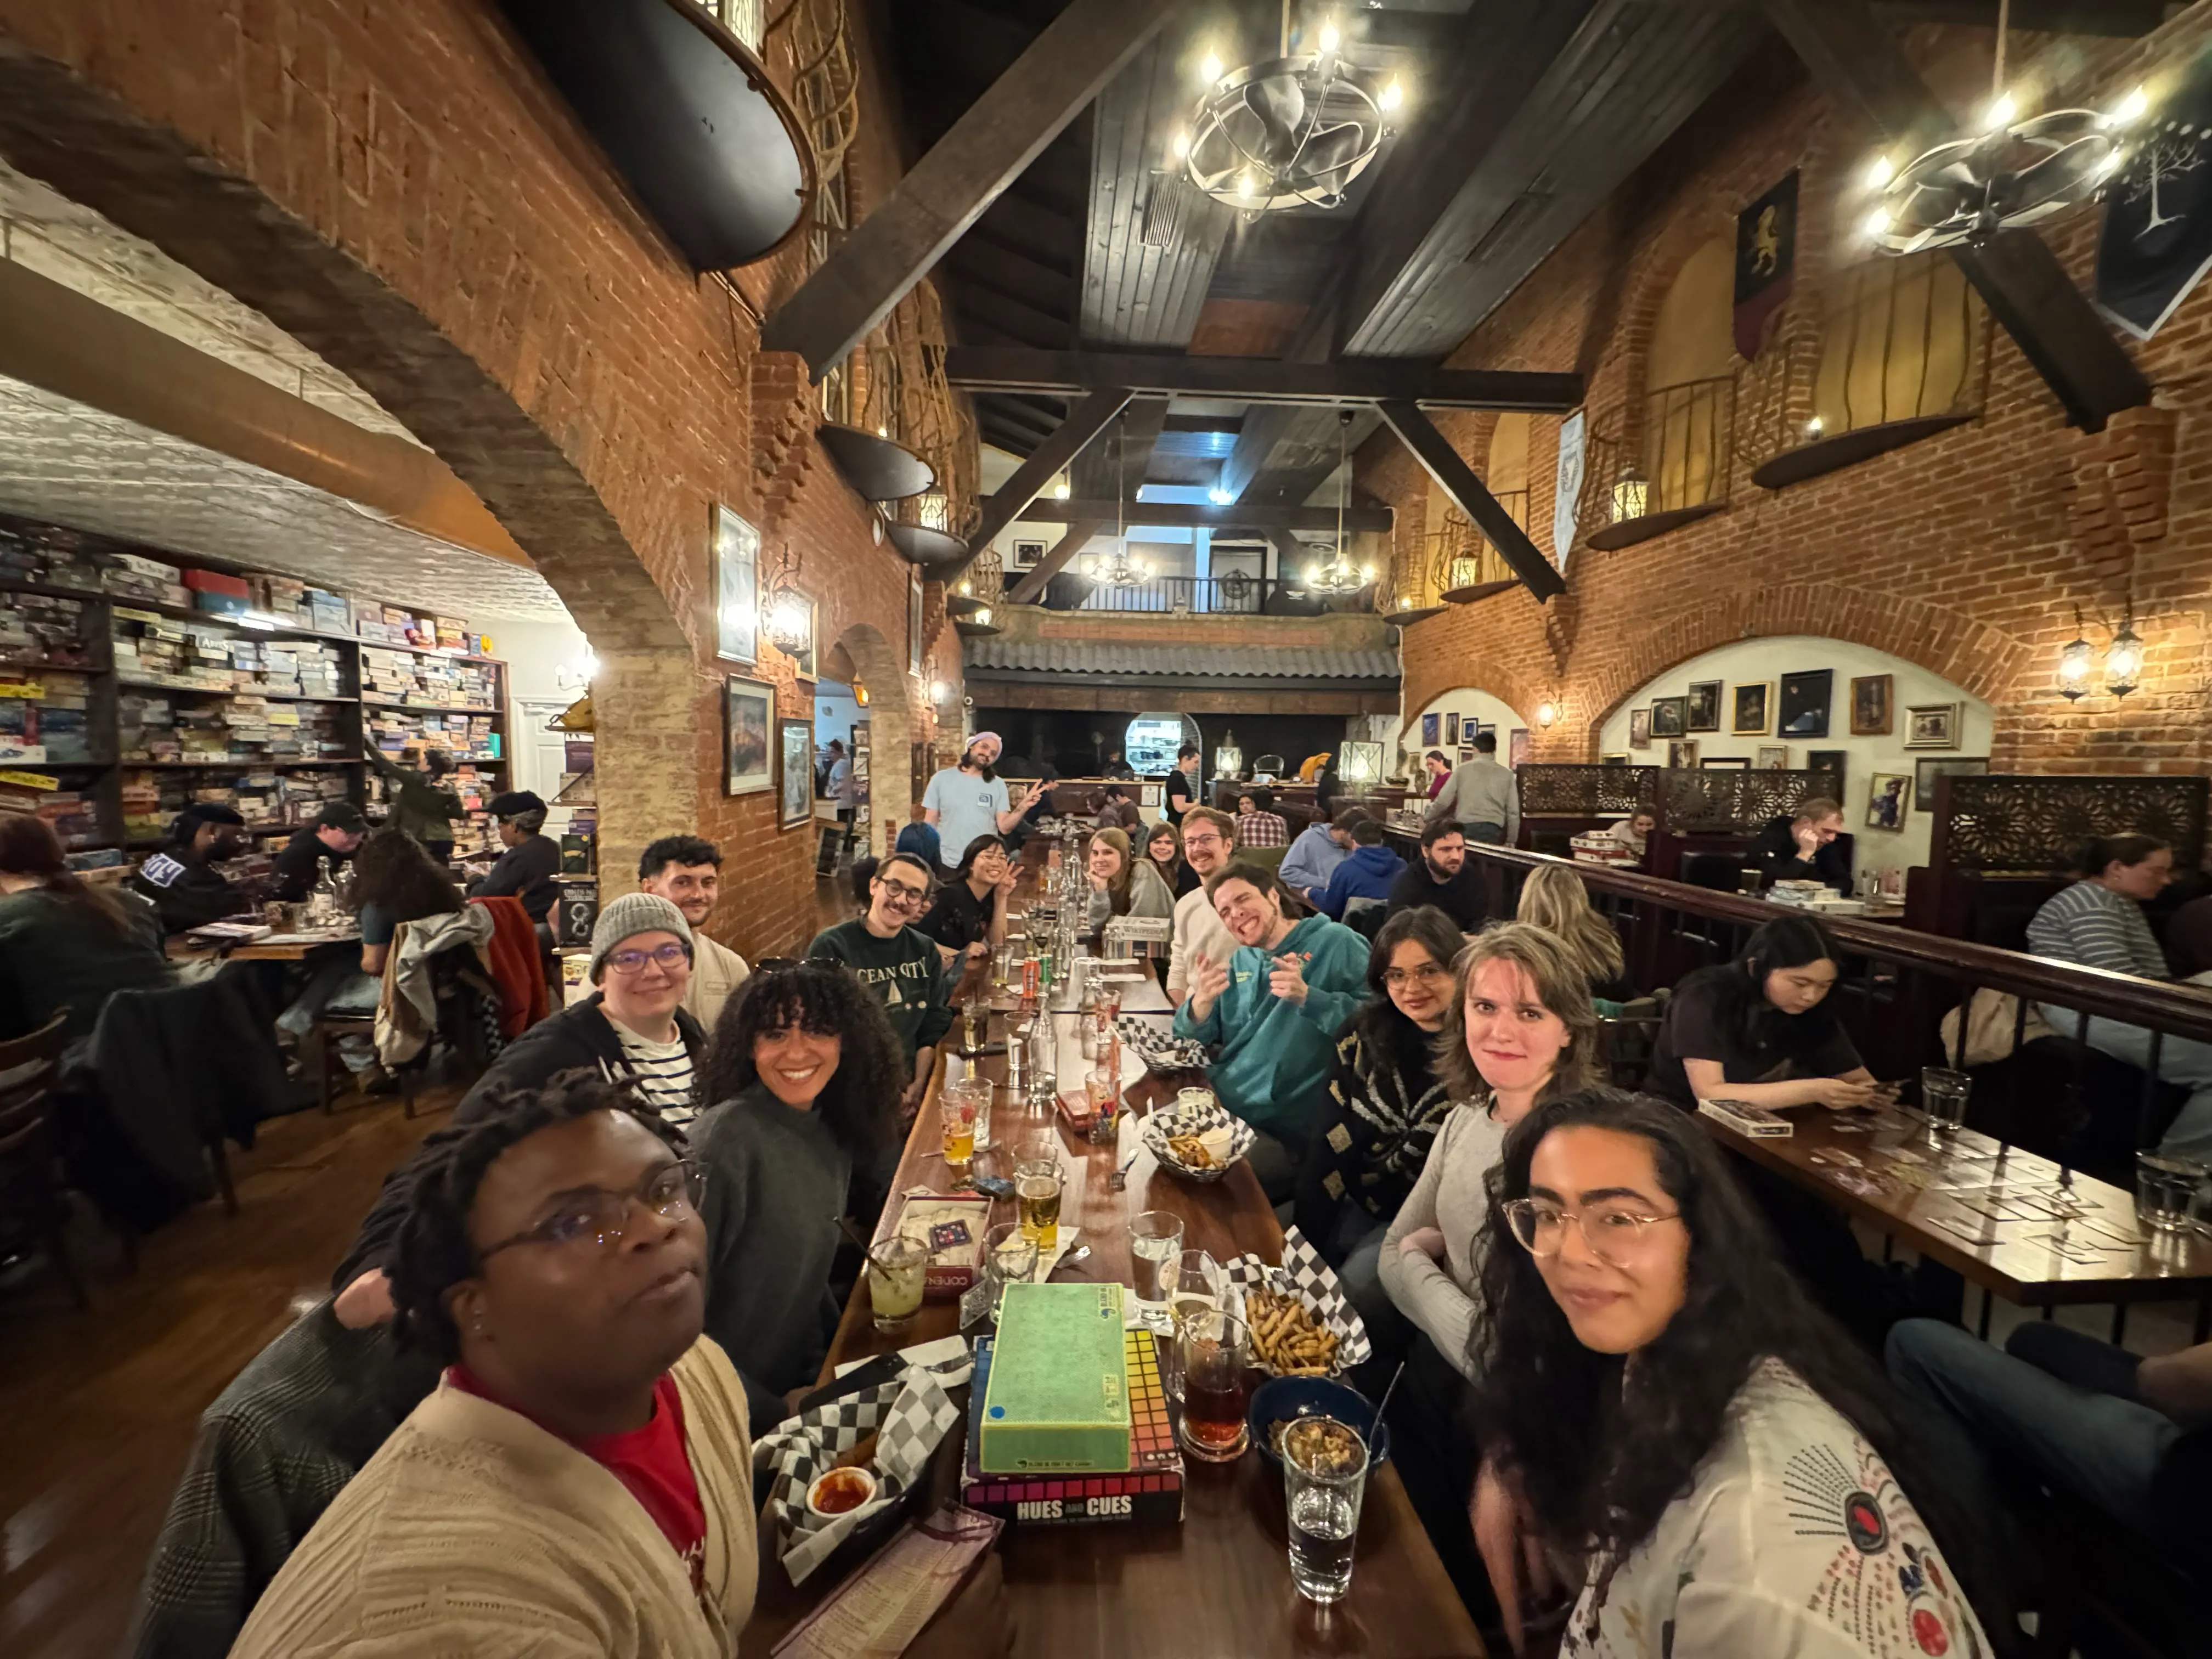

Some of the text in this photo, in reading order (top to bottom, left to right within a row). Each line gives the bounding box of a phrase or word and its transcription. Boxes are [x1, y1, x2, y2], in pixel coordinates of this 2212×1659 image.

[857, 967, 896, 983] CEAN
[924, 1276, 968, 1286] CODEN
[1017, 1500, 1063, 1520] HUES
[1086, 1496, 1132, 1516] CUES
